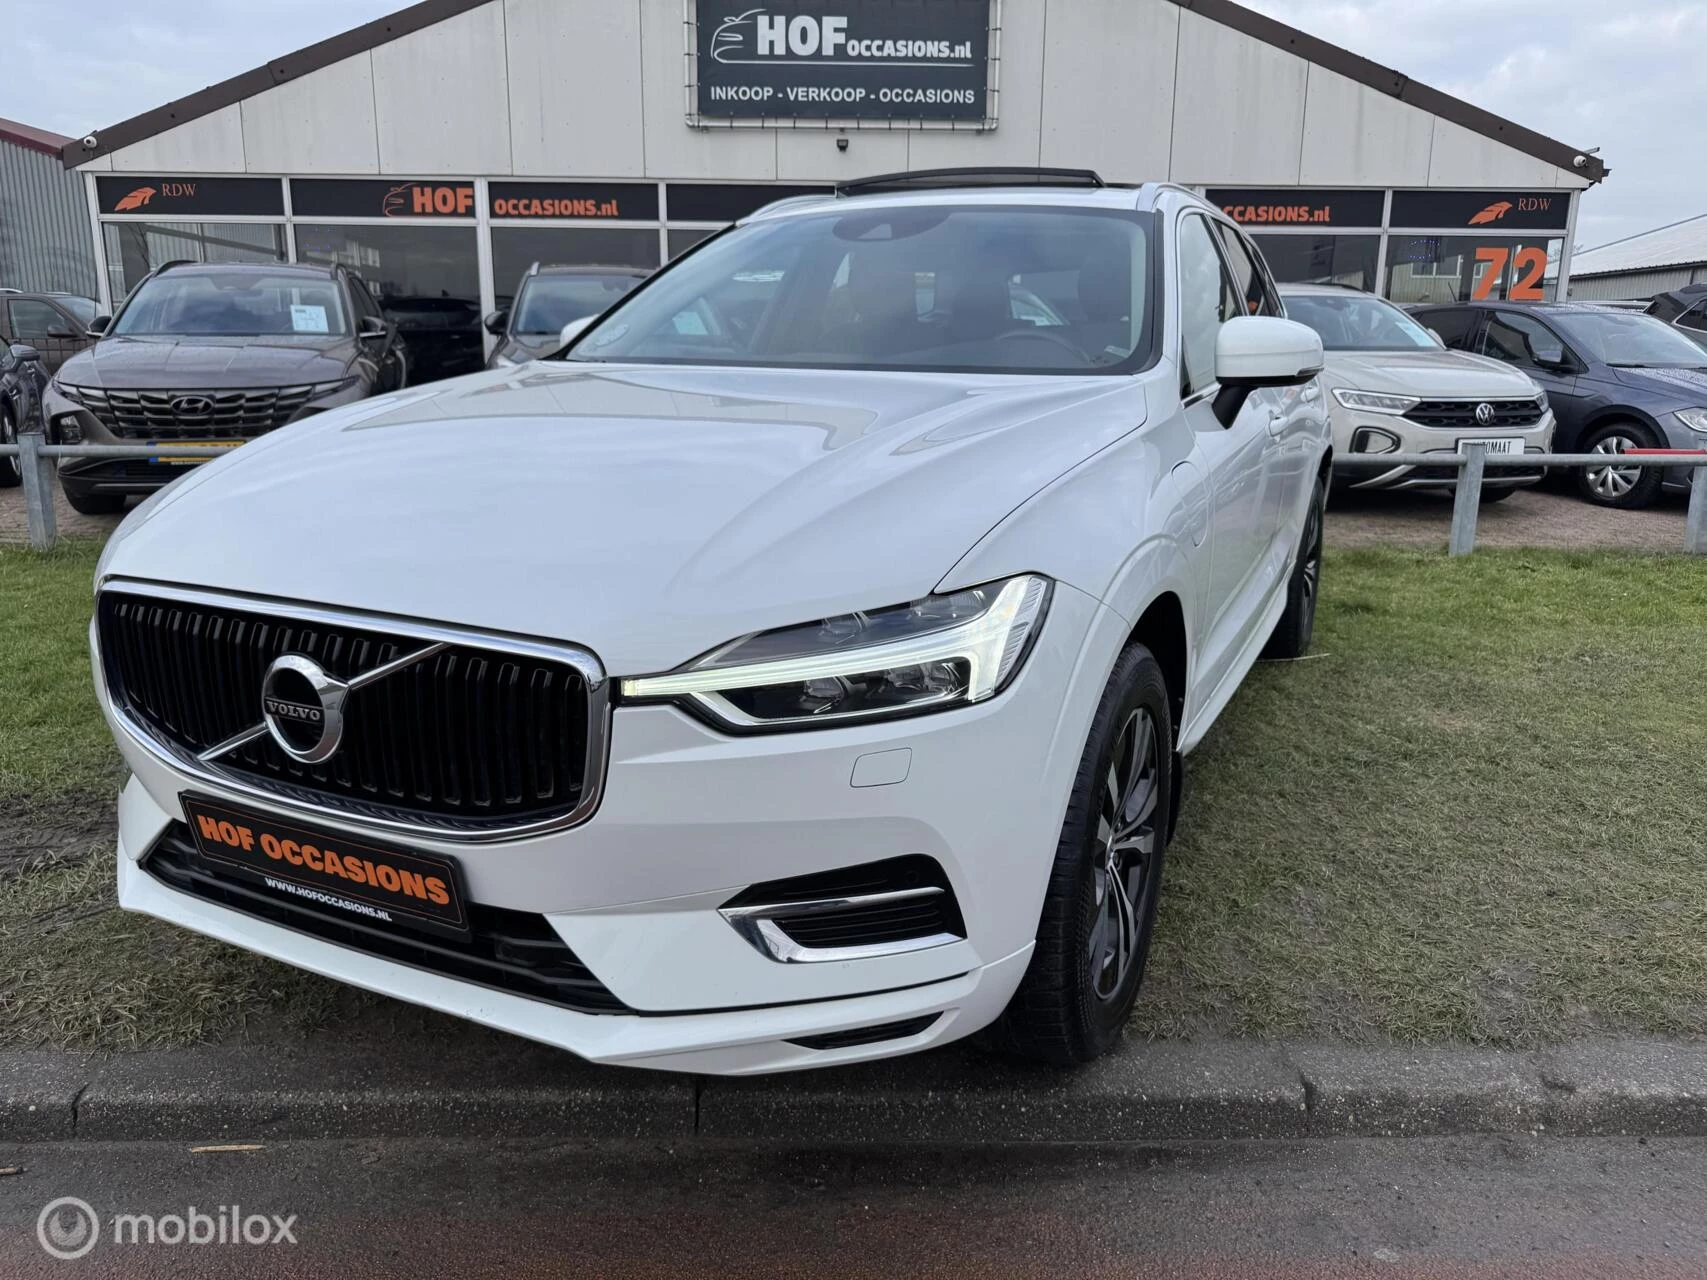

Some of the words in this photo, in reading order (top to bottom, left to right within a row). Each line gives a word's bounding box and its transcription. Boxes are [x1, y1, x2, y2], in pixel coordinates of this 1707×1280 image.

[757, 15, 848, 56] HOF
[711, 86, 774, 101] INKOOP
[786, 87, 866, 102] VERKOOP
[879, 88, 975, 104] OCCASIONS
[161, 183, 197, 197] RDW
[412, 187, 473, 213] HOF
[494, 199, 619, 216] OCCASIONS.nl
[1222, 206, 1331, 222] CASIONS.nl
[1518, 198, 1552, 211] RDW
[1472, 247, 1548, 302] 72
[266, 700, 321, 721] VOLVO
[197, 815, 255, 851] HOF
[260, 833, 450, 905] OCCASIONS
[264, 877, 393, 922] WWW.HOFOCCASIONS.NL
